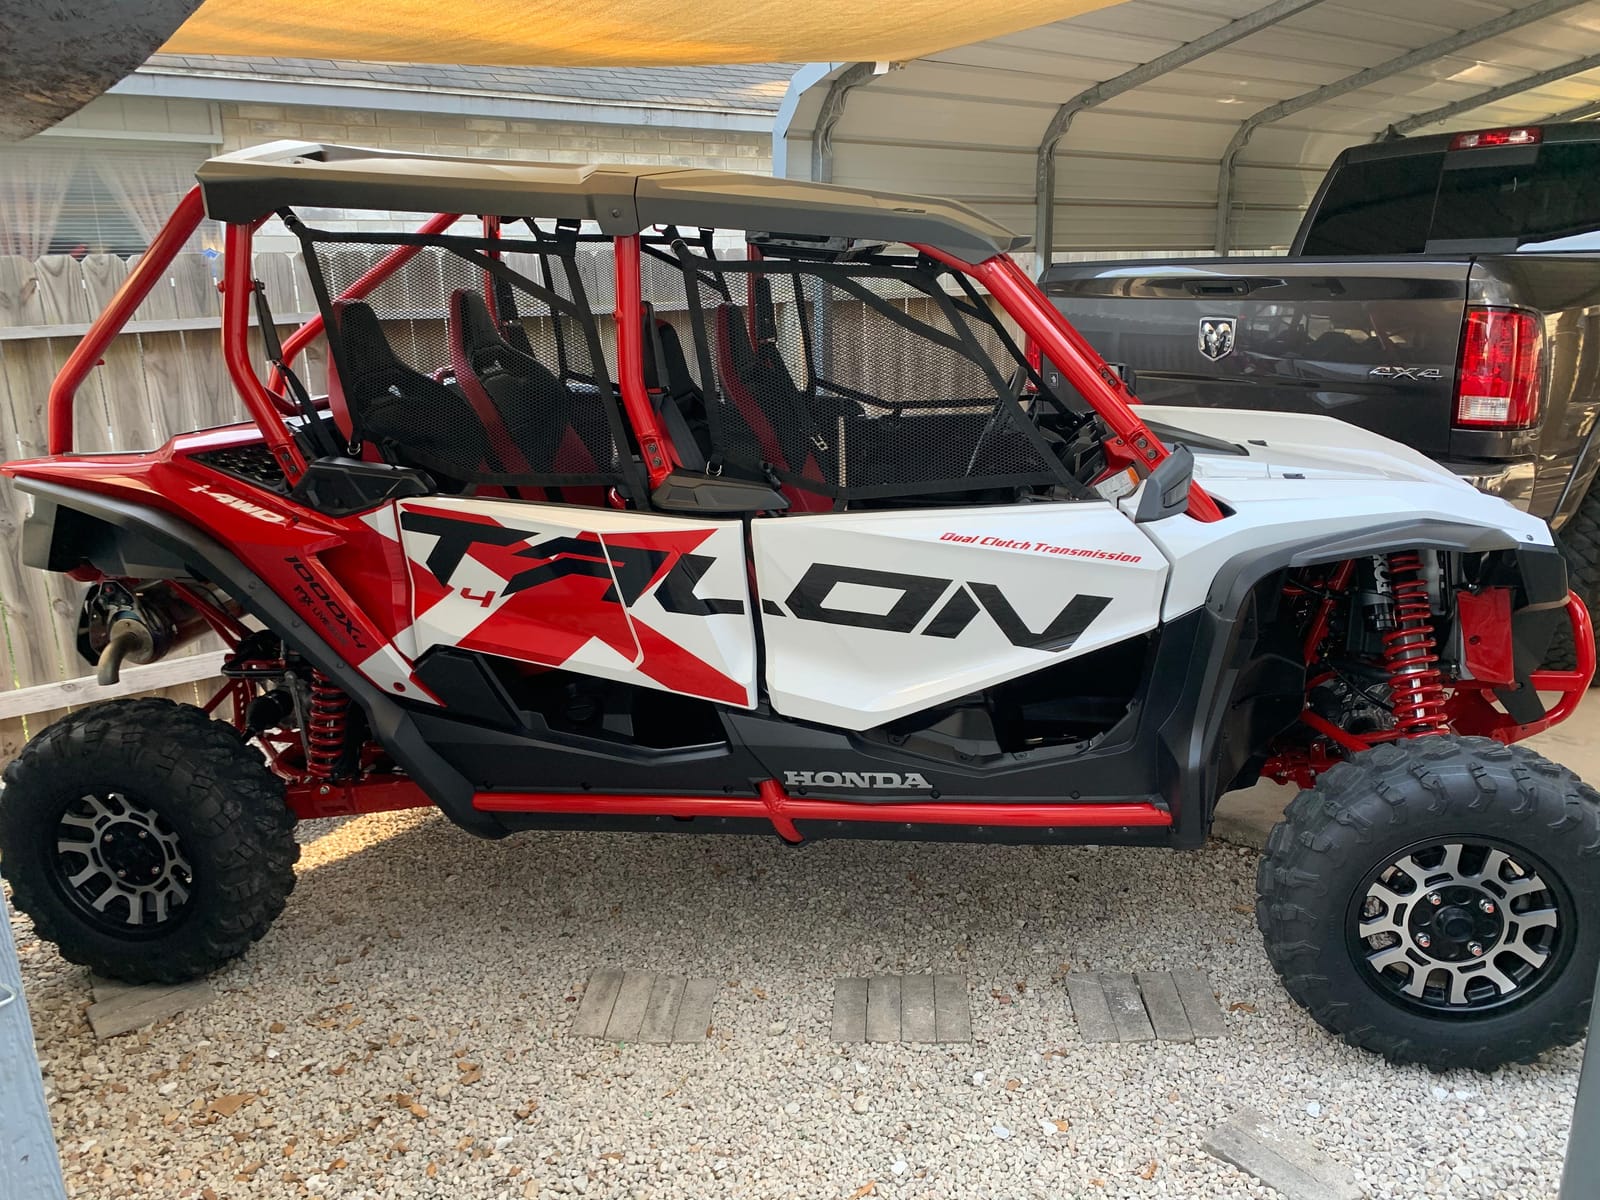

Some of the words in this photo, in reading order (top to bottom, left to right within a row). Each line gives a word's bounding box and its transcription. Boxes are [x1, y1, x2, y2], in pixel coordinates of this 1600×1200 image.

[188, 484, 285, 523] i-4WD
[939, 532, 979, 544] Dual
[980, 536, 1032, 550] Clutch
[1033, 542, 1142, 564] Transmission
[400, 511, 1114, 653] TALON
[459, 587, 496, 608] 4
[783, 770, 934, 789] HONDA
